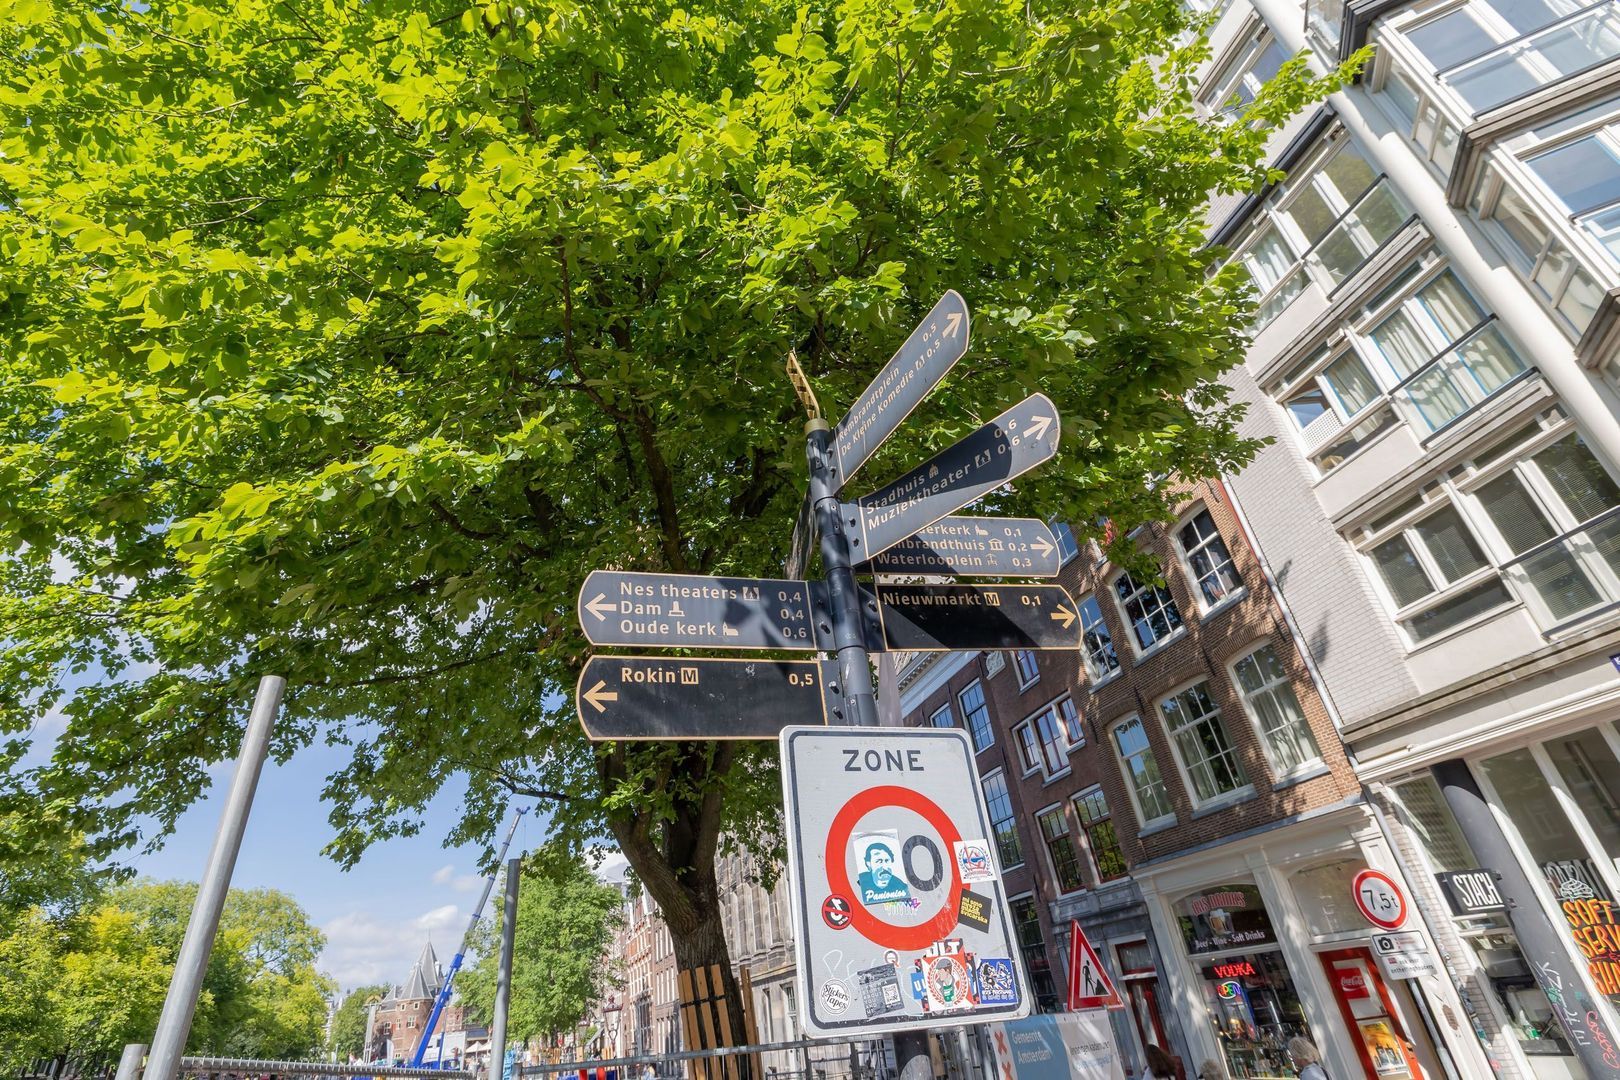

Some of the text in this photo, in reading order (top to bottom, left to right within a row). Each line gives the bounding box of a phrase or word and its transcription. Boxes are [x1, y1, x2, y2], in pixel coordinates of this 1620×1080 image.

[838, 323, 936, 442] Rembrandtplein 0,5
[840, 338, 941, 457] De Kleine Komedie 0,5
[867, 419, 1017, 515] Stadhuis 0,6
[869, 435, 1020, 530] Muziektheater 0,6
[919, 525, 1022, 537] erkerk 0,1
[1008, 543, 1028, 553] 0,2
[877, 553, 1032, 568] Waterlooplein 0,3
[620, 582, 802, 603] Nes theaters 0,4
[883, 592, 981, 606] Nieuwmarkt
[1021, 595, 1041, 606] 0,1
[620, 601, 804, 621] Dam 0,4
[620, 620, 807, 639] Oude kerk 0,6
[621, 667, 676, 683] Rokin
[788, 673, 814, 686] 0,5
[842, 749, 925, 772] ZONE
[901, 834, 944, 892] 0
[1452, 872, 1504, 907] STACH
[1562, 899, 1615, 928] SOFT
[1231, 933, 1244, 943] Soft
[1244, 930, 1265, 941] Drinks
[1214, 962, 1255, 978] VODKA
[823, 984, 849, 1002] Stickers
[1216, 982, 1241, 997] OPEN
[826, 993, 847, 1009] Tapes
[1012, 1031, 1042, 1044] Gemeente
[1018, 1048, 1051, 1065] Amsterdam
